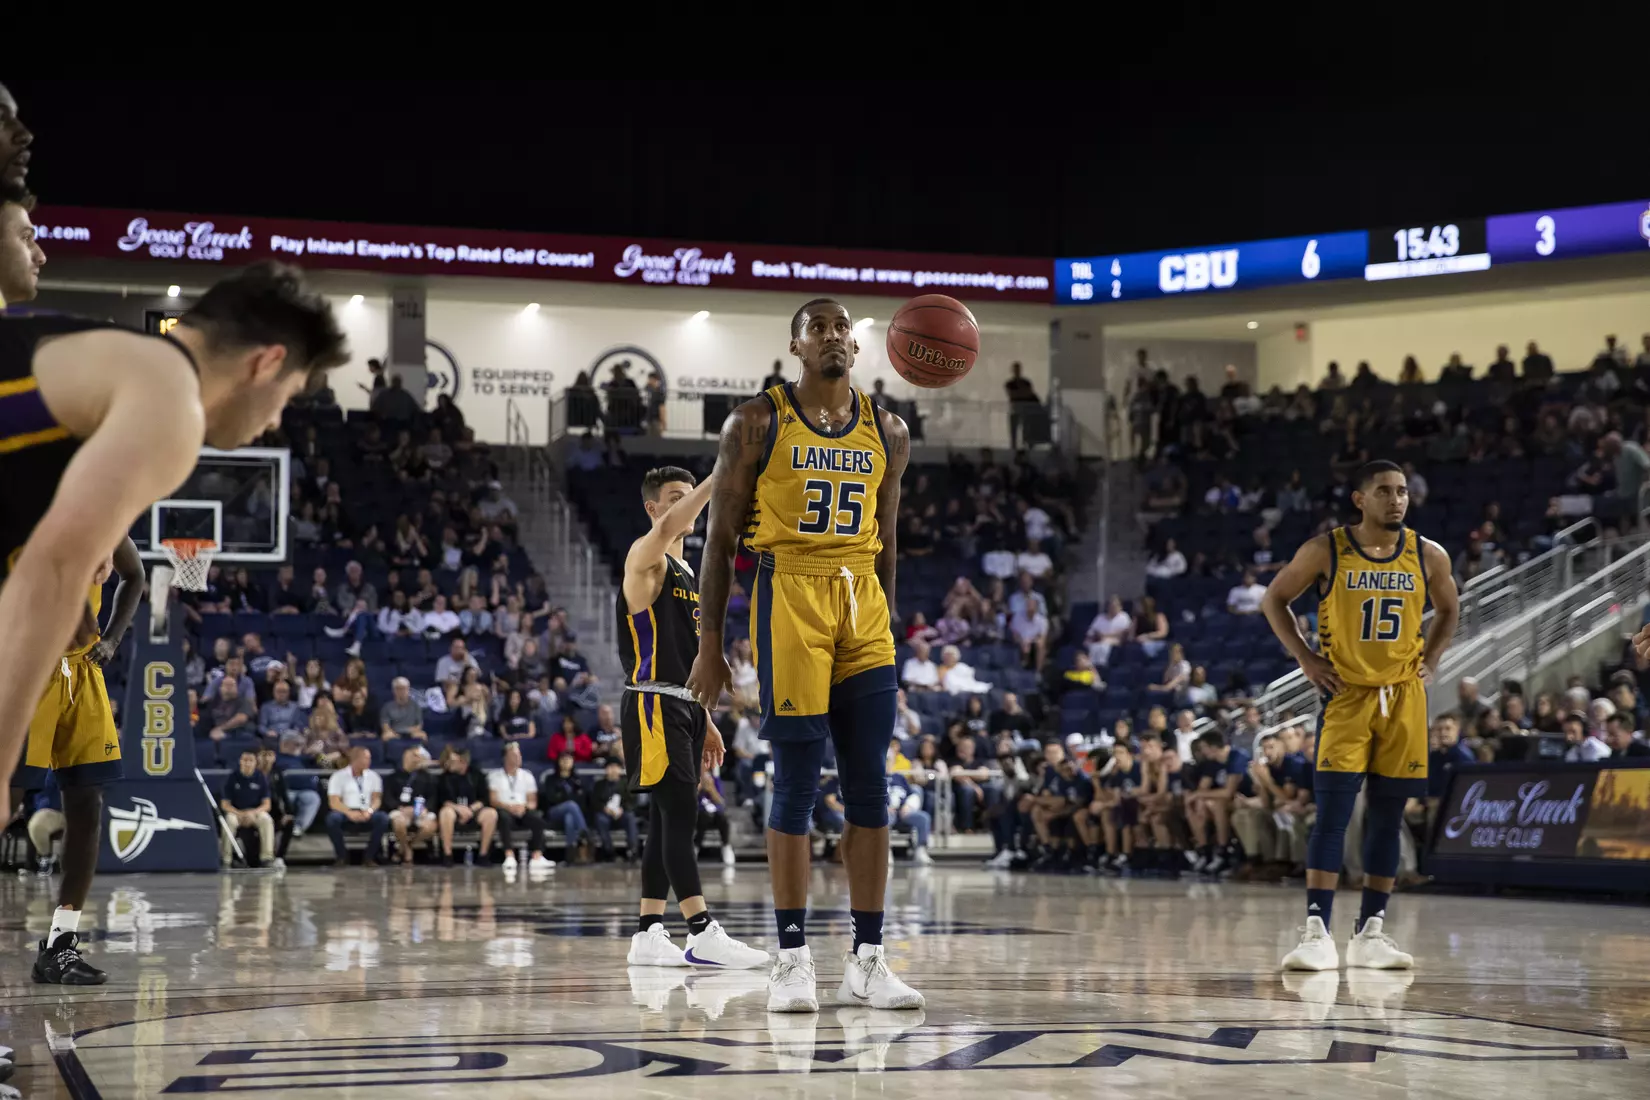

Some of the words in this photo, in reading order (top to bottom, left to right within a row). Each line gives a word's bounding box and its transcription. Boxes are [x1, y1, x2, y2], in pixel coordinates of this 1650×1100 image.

[117, 217, 186, 251] Goose
[184, 221, 252, 249] Creek
[1535, 215, 1556, 256] 3
[149, 244, 185, 258] GOLF
[187, 246, 223, 260] CLUB
[270, 234, 305, 255] Play
[307, 237, 355, 255] Inland
[356, 239, 424, 260] Empire's
[425, 243, 456, 263] Top
[457, 245, 501, 263] Rated
[502, 247, 536, 265] Golf
[536, 249, 595, 268] Course!
[614, 243, 677, 277] Goose
[673, 247, 736, 275] Creek
[641, 269, 676, 283] GOLF
[676, 270, 710, 285] CLUB
[752, 260, 790, 277] Book
[860, 267, 875, 282] at
[1159, 249, 1240, 293] CBU
[1301, 239, 1321, 279] 6
[1111, 279, 1122, 298] 2
[908, 340, 966, 369] Wilson
[472, 368, 554, 382] EQUIPPED
[473, 383, 494, 395] TO
[500, 384, 550, 396] SERVE
[677, 376, 758, 390] GLOBALLY
[791, 445, 874, 475] LANCERS
[797, 478, 867, 536] 35
[1346, 570, 1416, 592] LANCERS
[1359, 596, 1405, 642] 15
[141, 661, 175, 776] CBU
[1445, 779, 1517, 839] Goose
[1518, 780, 1585, 826] Creek
[1470, 827, 1507, 848] GOLF
[1505, 827, 1544, 848] CLUB
